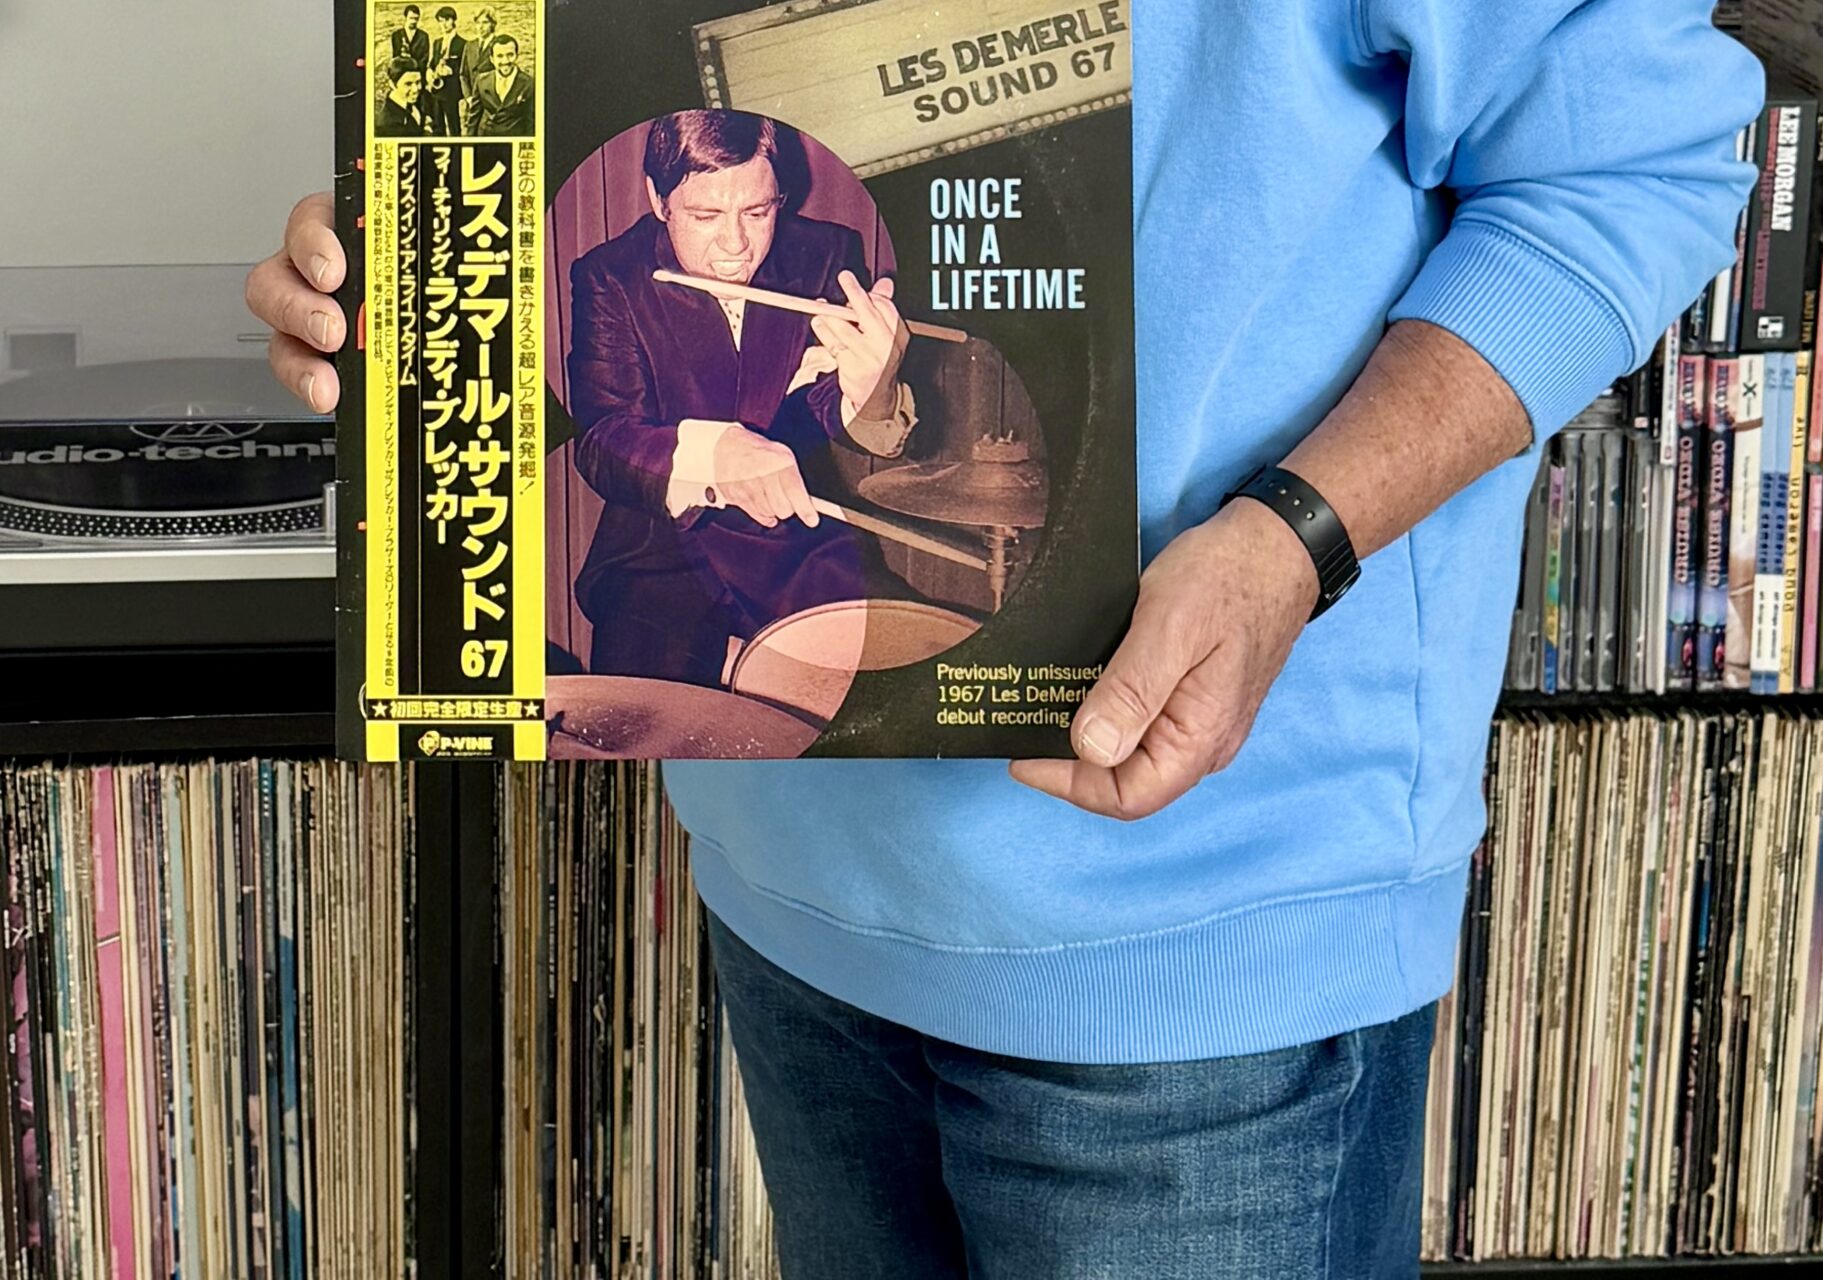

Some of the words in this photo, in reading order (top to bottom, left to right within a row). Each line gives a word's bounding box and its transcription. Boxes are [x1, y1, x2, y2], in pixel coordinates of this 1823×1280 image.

[877, 48, 947, 97] LES
[952, 0, 1127, 75] DEMERLE
[912, 61, 1058, 123] SOUND
[1071, 42, 1116, 80] 67
[1779, 106, 1801, 145] LEE
[930, 177, 1022, 219] ONCE
[1771, 146, 1798, 232] MORGAN
[931, 224, 966, 265] IN
[979, 224, 1001, 265] A
[931, 269, 1086, 311] LIFETIME
[937, 663, 1022, 684] Previously
[1028, 663, 1102, 680] unissued
[938, 685, 984, 703] 1967
[991, 685, 1020, 703] Les
[1026, 685, 1090, 703] DeMerl
[936, 708, 986, 725] debut
[991, 708, 1070, 728] recording
